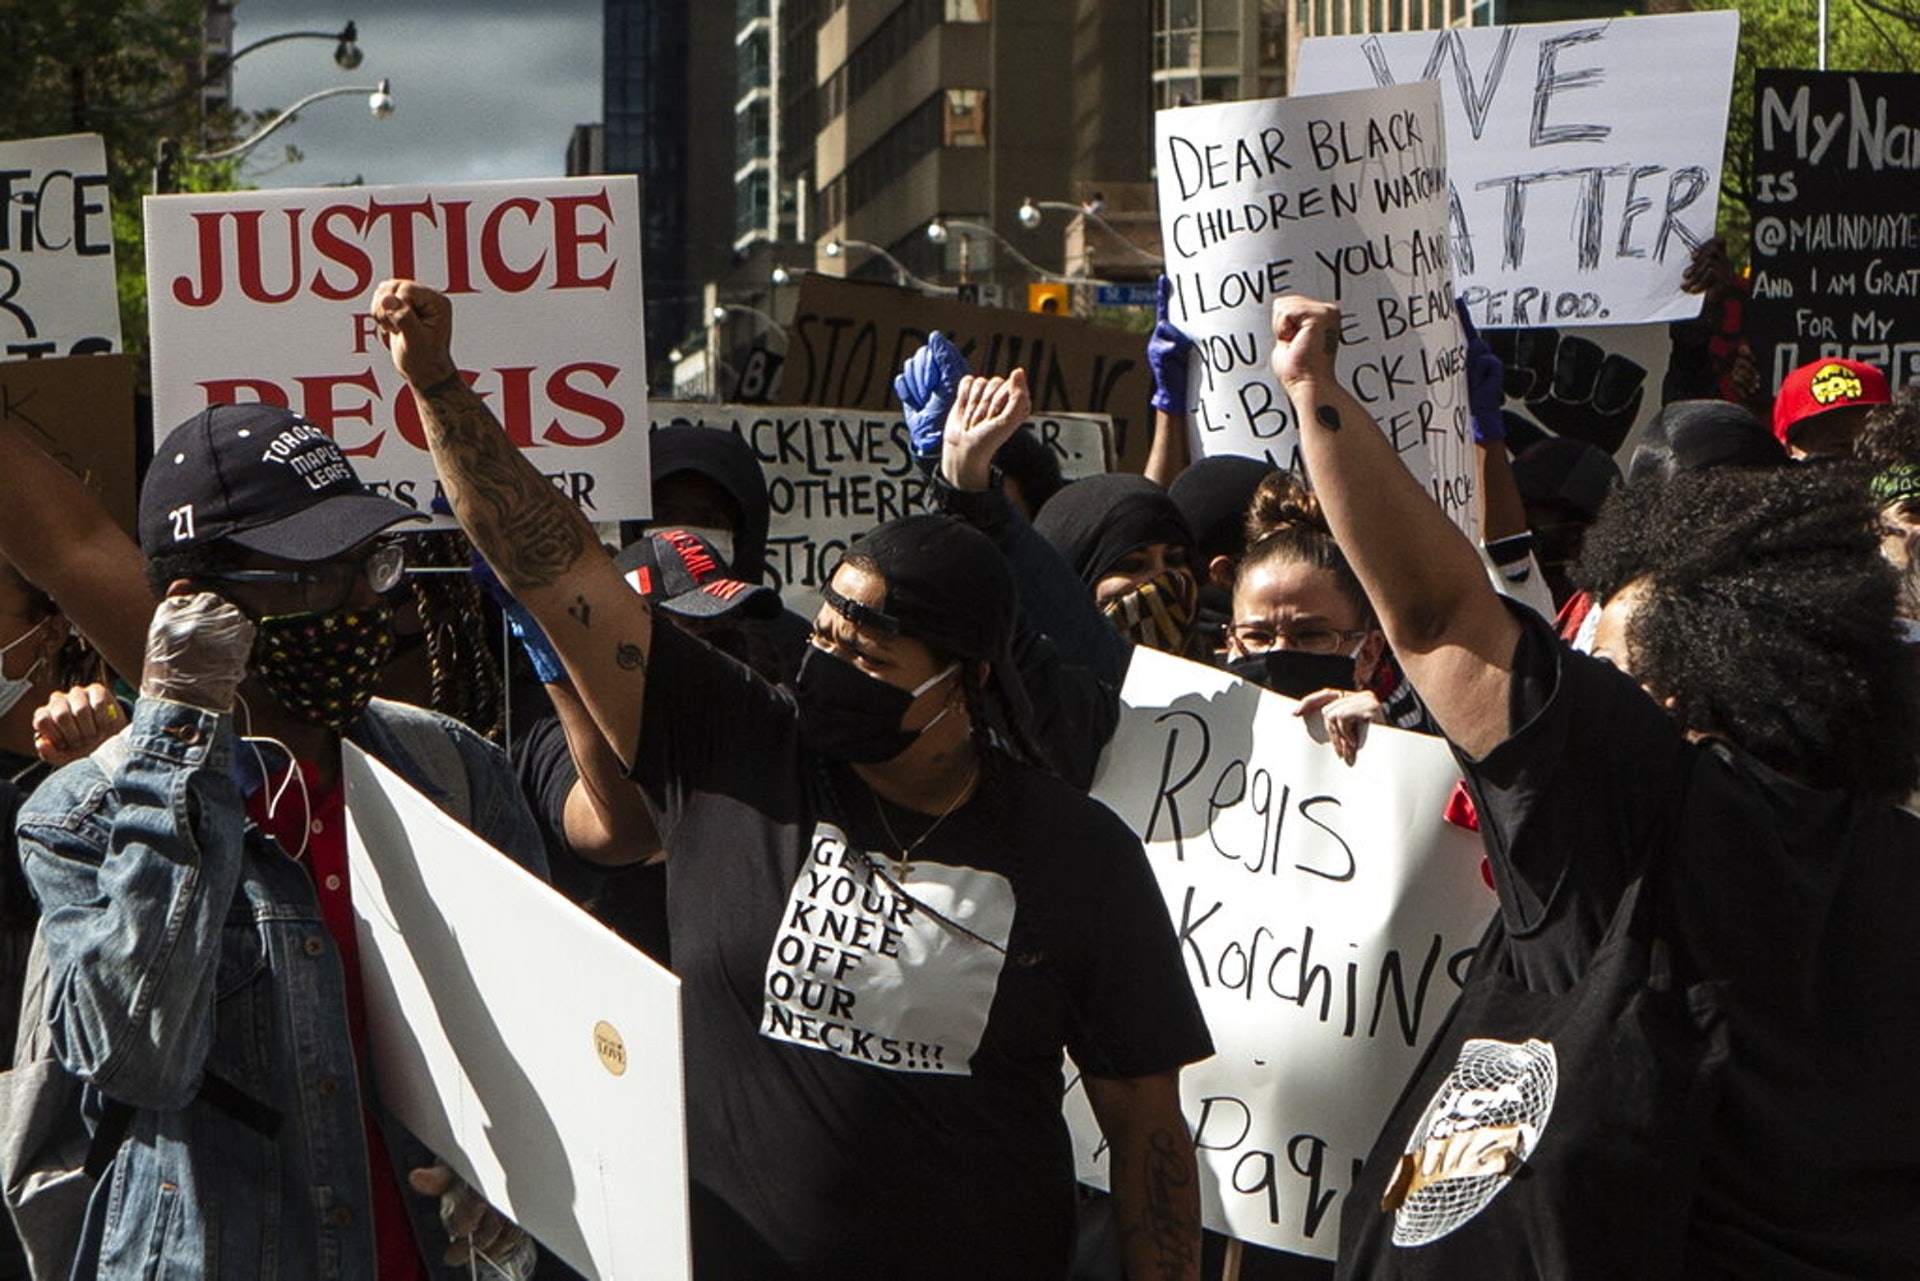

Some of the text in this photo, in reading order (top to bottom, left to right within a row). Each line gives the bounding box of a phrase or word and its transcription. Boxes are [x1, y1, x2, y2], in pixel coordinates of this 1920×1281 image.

[1361, 18, 1612, 149] WE
[1847, 76, 1920, 171] Na
[1169, 109, 1422, 201] DEAR BLACK
[1757, 170, 1798, 201] IS
[172, 187, 618, 307] JUSTICE
[1173, 187, 1358, 259] CHILDREN
[1176, 273, 1188, 322] I
[1195, 259, 1293, 314] LOVE
[1315, 235, 1393, 300] YOU
[1752, 270, 1793, 299] AND
[1811, 267, 1817, 293] I
[1827, 274, 1855, 295] AM
[1796, 308, 1837, 339] FOR
[1192, 333, 1257, 392] YOU
[290, 444, 342, 475] MAPLE
[168, 504, 195, 541] 27
[808, 870, 914, 926] YOUR
[777, 935, 862, 981] OFF
[789, 899, 903, 959] KNEE
[769, 970, 857, 1021] OUR
[767, 1003, 945, 1071] NECKS!!!
